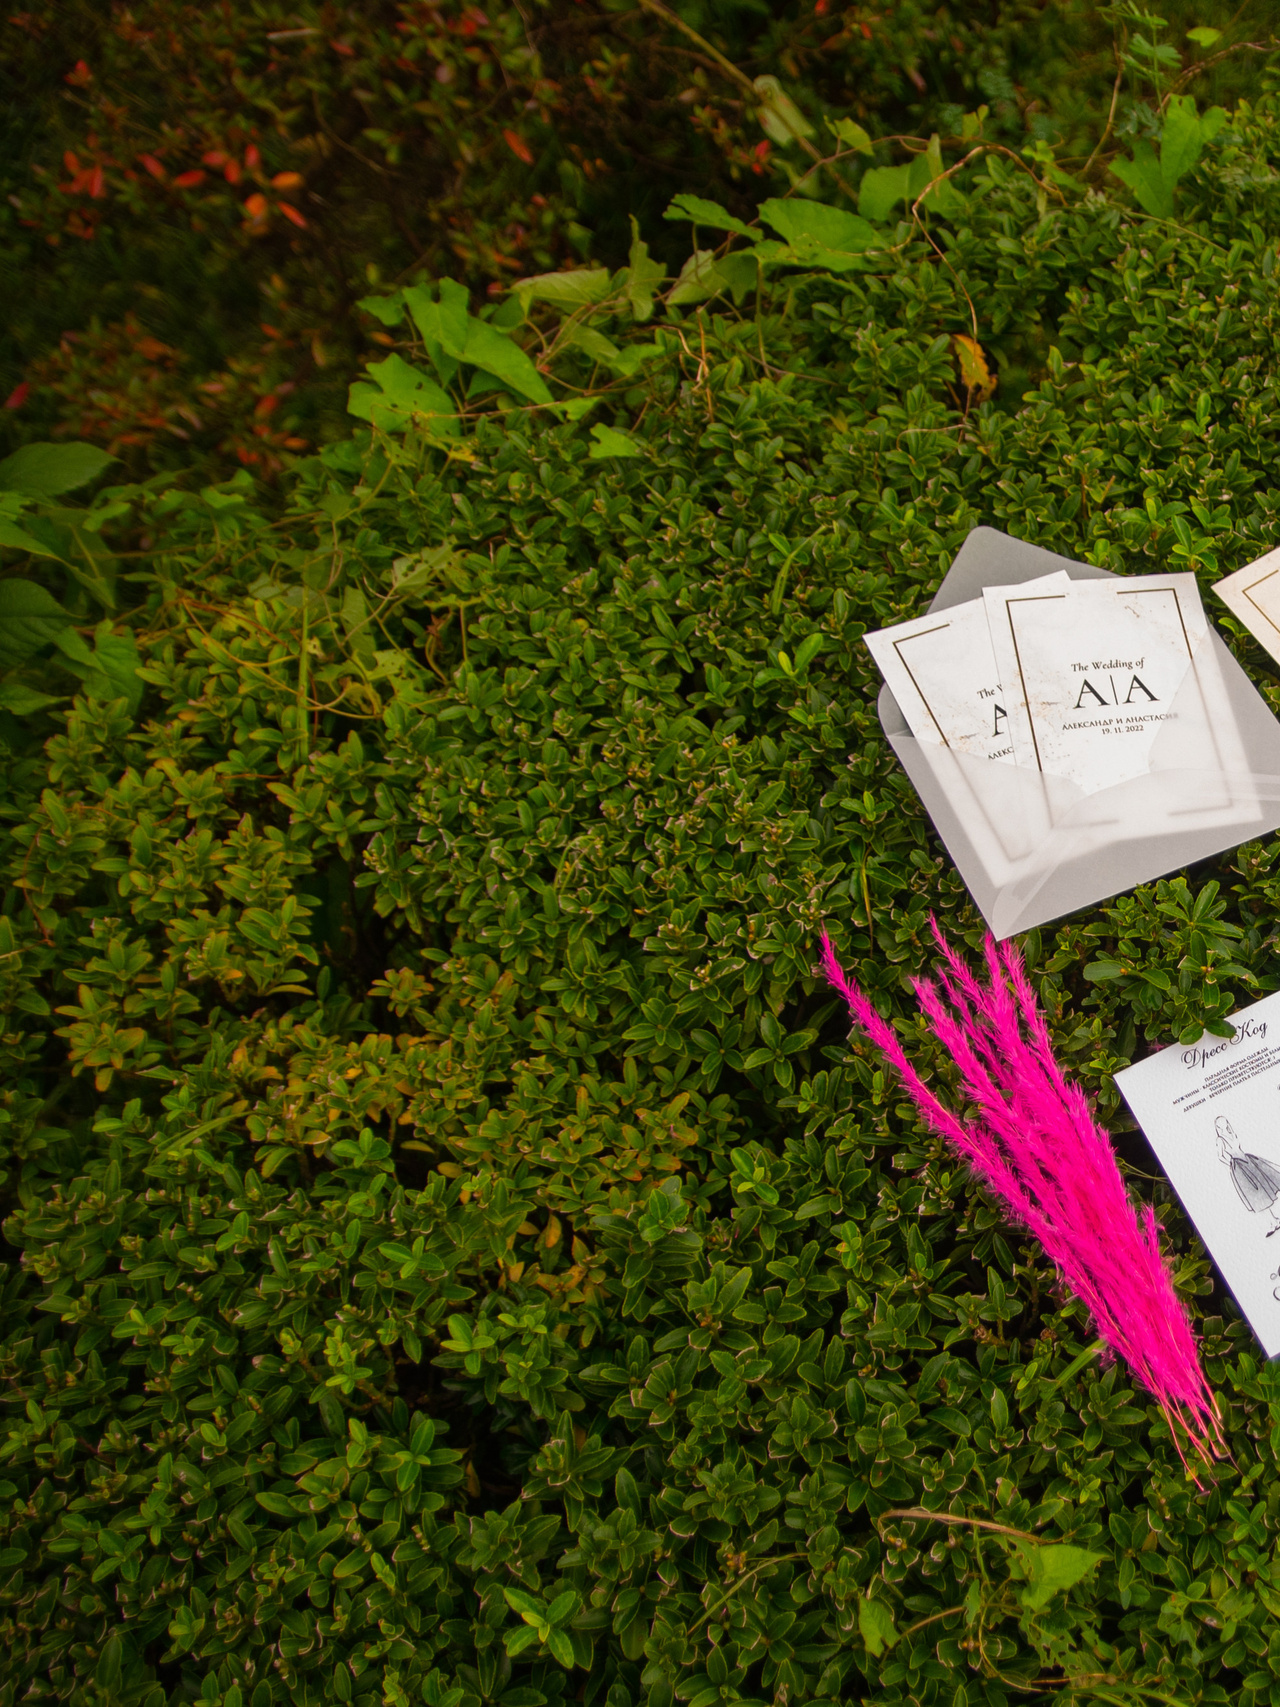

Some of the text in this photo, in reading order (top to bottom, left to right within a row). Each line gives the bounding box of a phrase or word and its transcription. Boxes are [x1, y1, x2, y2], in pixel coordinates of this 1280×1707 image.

[1071, 657, 1145, 672] The Wedding of
[977, 688, 995, 699] The
[1062, 718, 1114, 731] АЛЕКСАНДР
[1125, 712, 1179, 724] АНАСТАСИЯ
[988, 746, 1015, 761] АЛЕКС
[1180, 1018, 1268, 1069] Дресс Код
